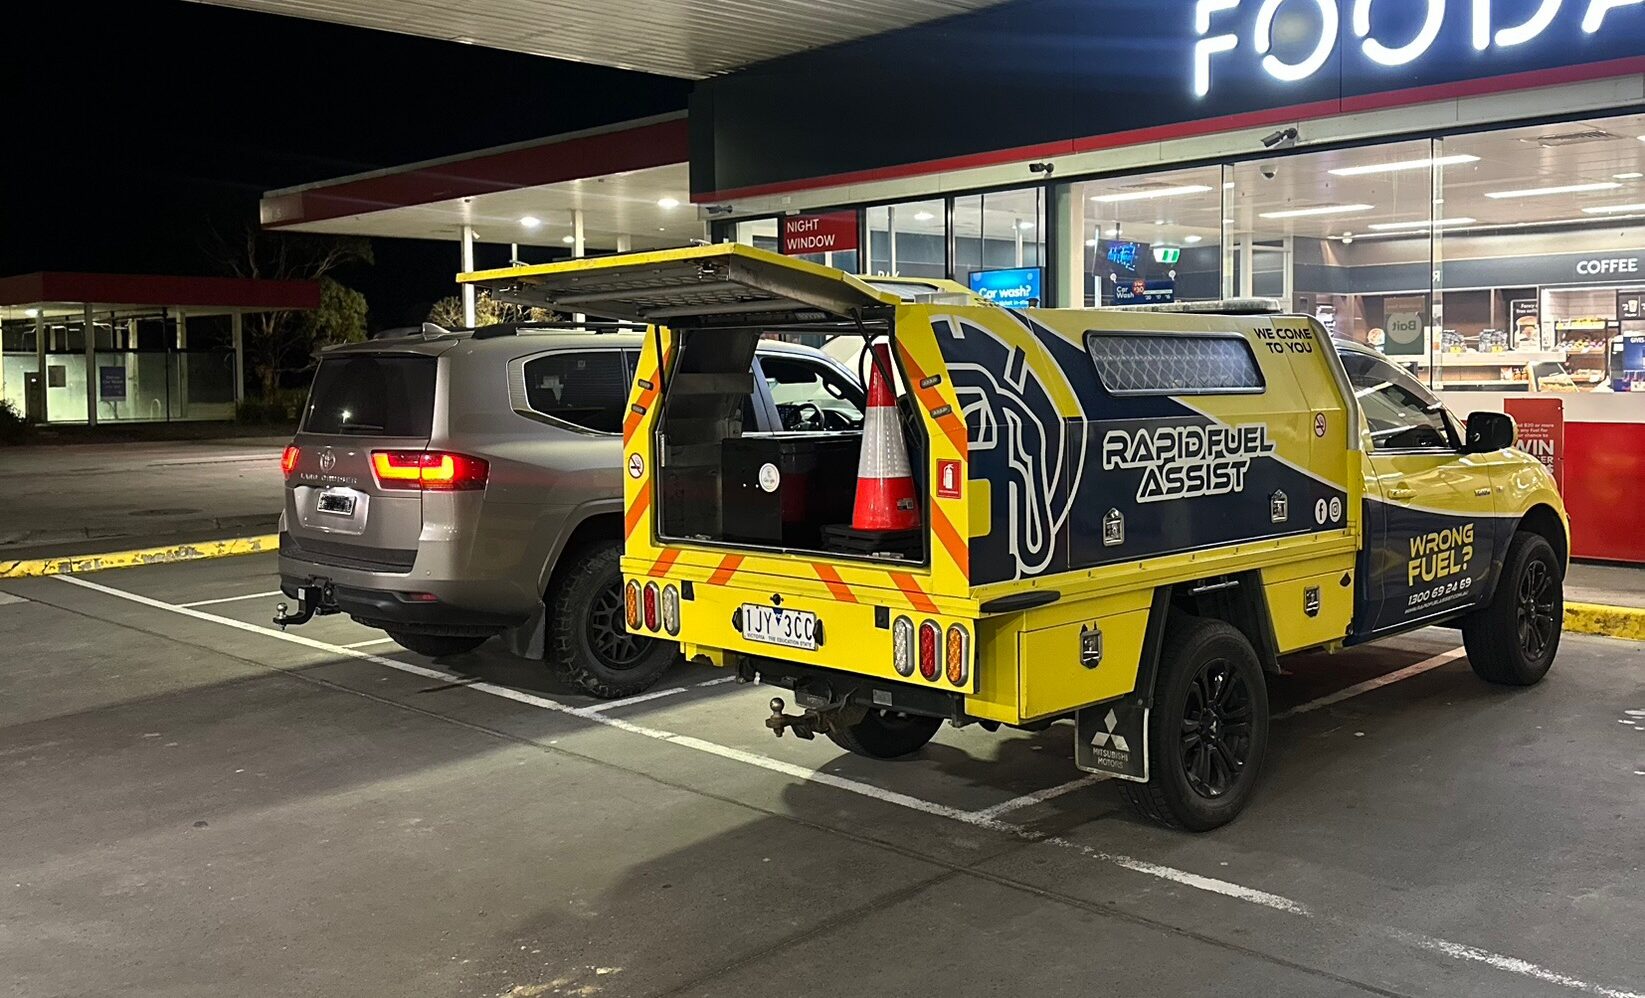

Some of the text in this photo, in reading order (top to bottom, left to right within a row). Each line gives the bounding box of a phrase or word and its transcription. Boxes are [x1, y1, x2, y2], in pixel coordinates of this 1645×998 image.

[786, 219, 819, 233] NIGHT
[786, 234, 835, 250] WINDOW
[1576, 258, 1638, 275] COFFEE
[979, 285, 1032, 299] Car wash?
[1253, 328, 1313, 340] WE COME
[1265, 342, 1313, 354] TO YOU
[1516, 439, 1554, 456] WIN
[1136, 459, 1250, 503] ASSIST
[1409, 523, 1474, 558] WRONG
[1408, 545, 1473, 587] FUEL?
[1408, 577, 1472, 606] 1300 69 24 69
[746, 609, 812, 641] 1JY 3CC
[777, 637, 800, 646] EDUCATION
[800, 640, 812, 648] STATE
[1092, 747, 1129, 762] MITSUBISHI
[1097, 757, 1124, 769] MOTORS
